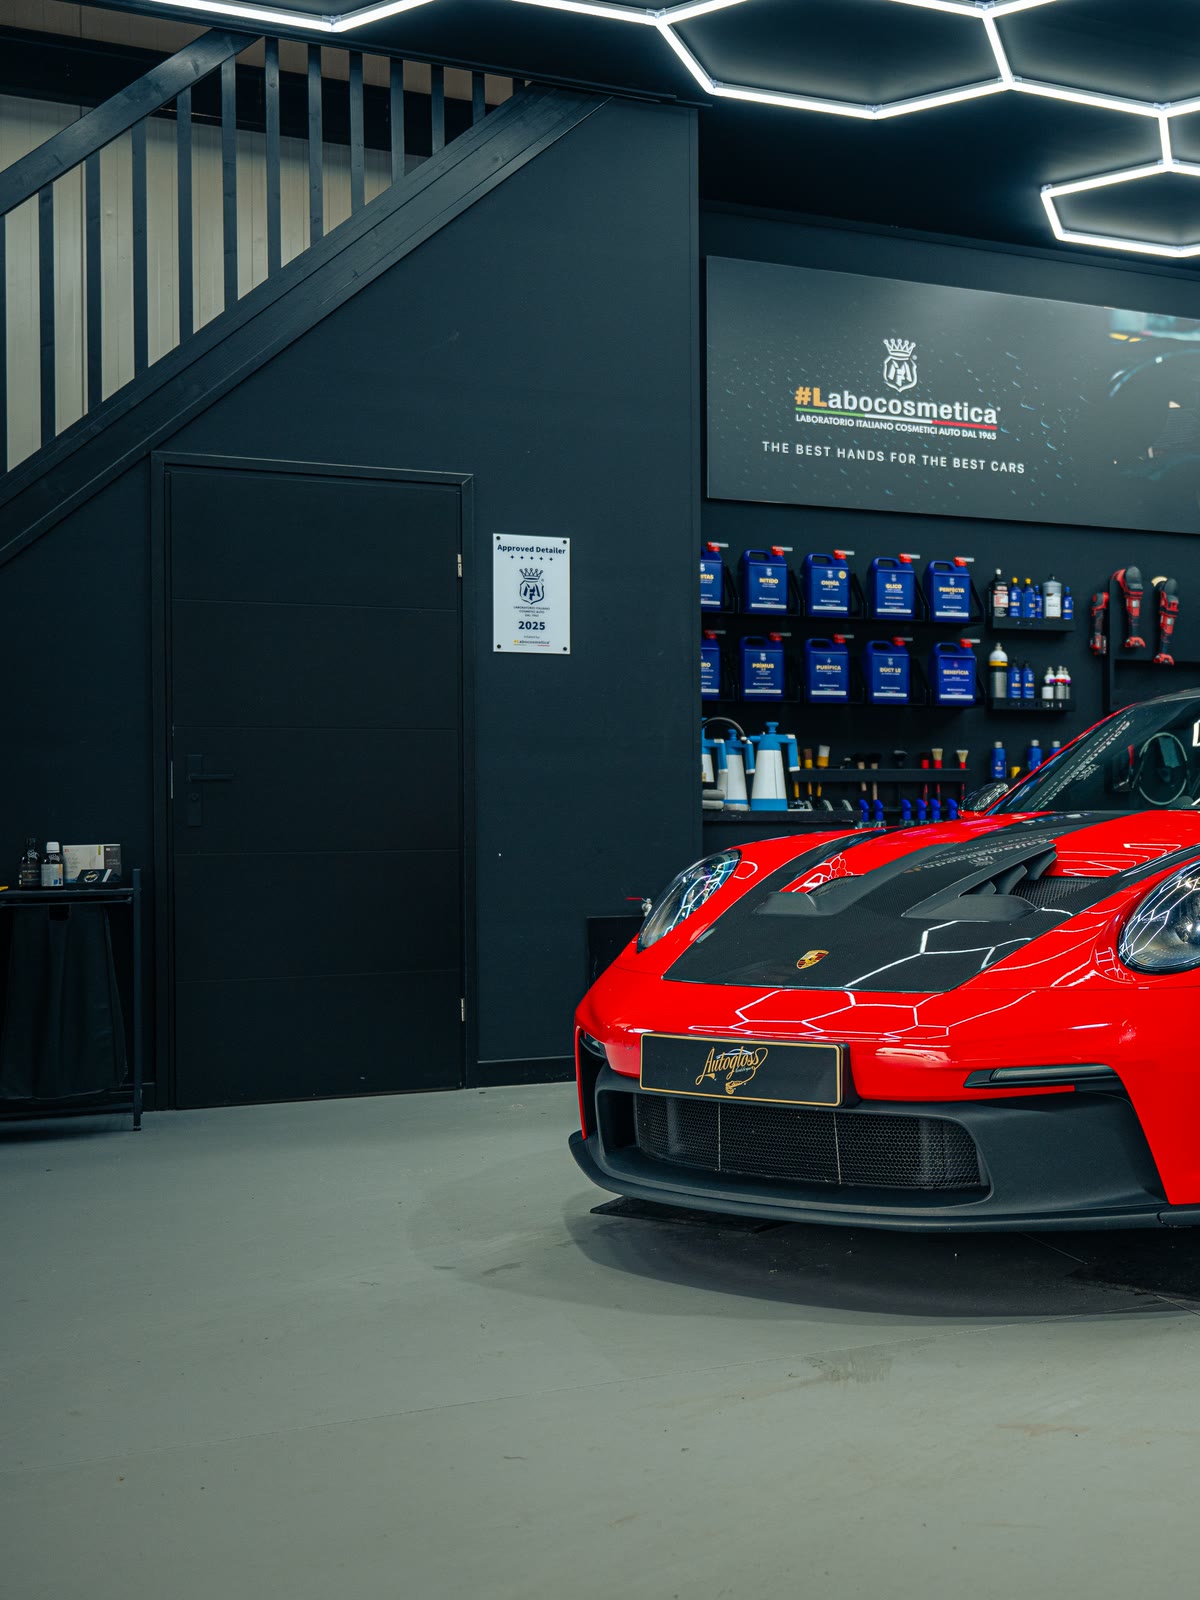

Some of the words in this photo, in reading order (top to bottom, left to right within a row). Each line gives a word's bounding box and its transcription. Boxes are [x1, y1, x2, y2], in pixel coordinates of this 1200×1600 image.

[794, 386, 998, 424] #Labocosmetica
[795, 414, 855, 427] LABORATORIO
[856, 419, 894, 431] ITALIANO
[895, 424, 938, 435] COSMETICI
[939, 428, 961, 437] AUTO
[962, 430, 977, 438] DAL
[978, 431, 997, 441] 1965
[762, 441, 789, 454] THE
[796, 444, 831, 458] BEST
[837, 448, 885, 462] HANDS
[890, 452, 917, 465] FOR
[922, 455, 947, 467] THE
[953, 458, 986, 471] BEST
[991, 461, 1025, 474] CARS
[497, 544, 534, 553] Approved
[536, 546, 566, 555] Detailer
[518, 621, 546, 631] 2025
[695, 1045, 768, 1086] Autogloss
